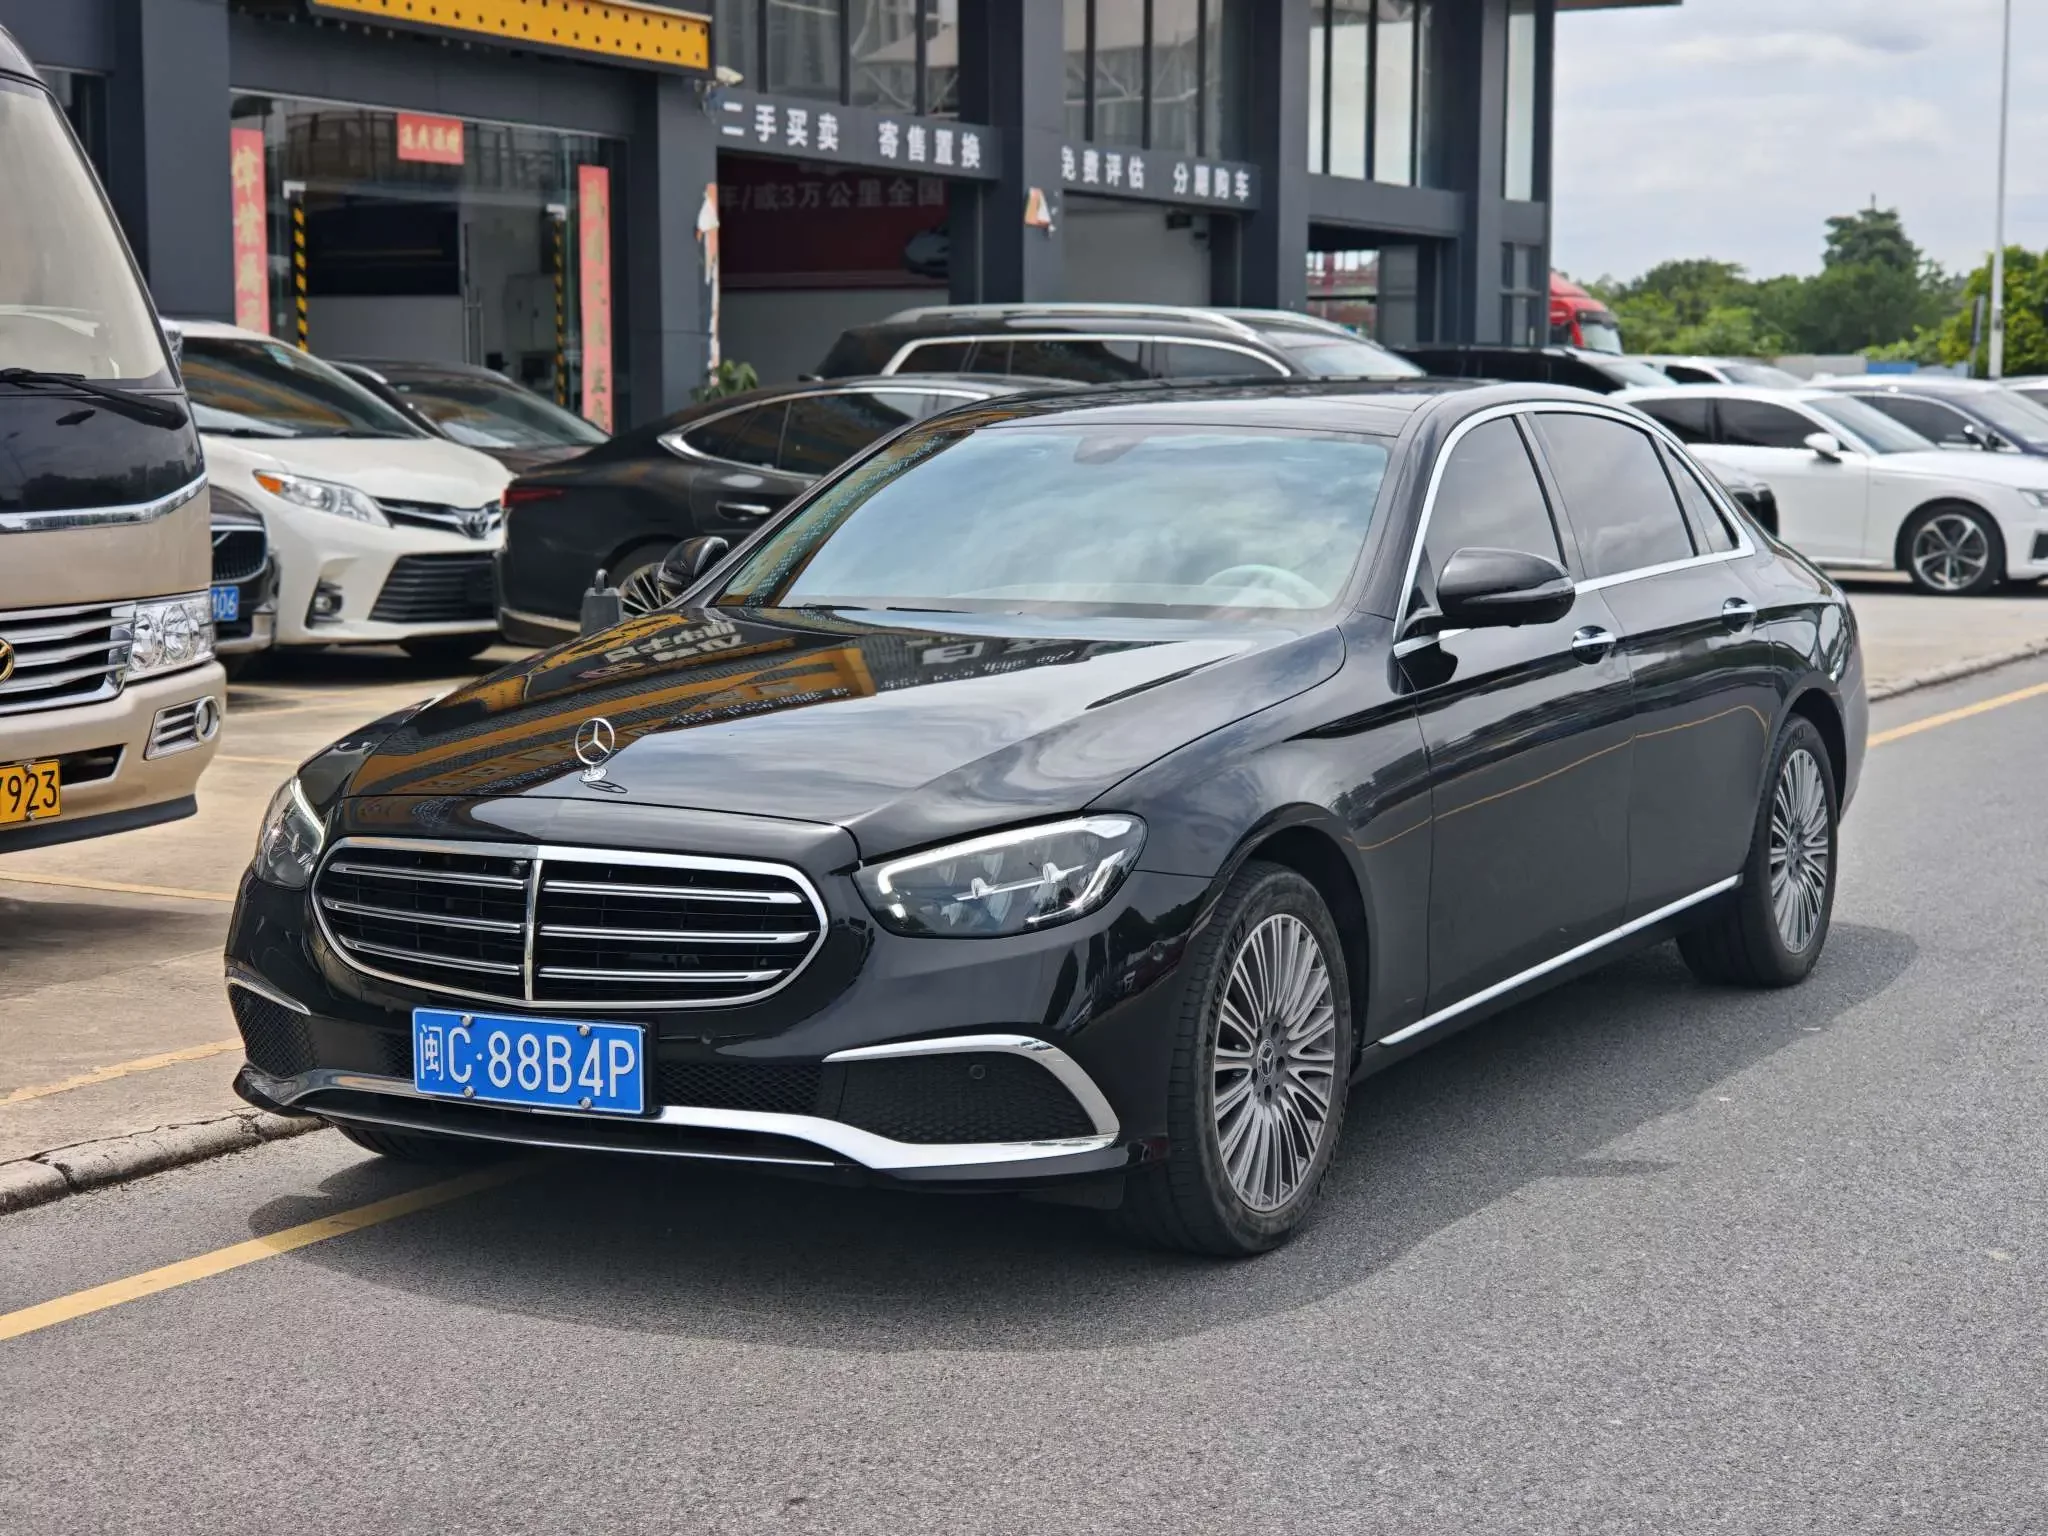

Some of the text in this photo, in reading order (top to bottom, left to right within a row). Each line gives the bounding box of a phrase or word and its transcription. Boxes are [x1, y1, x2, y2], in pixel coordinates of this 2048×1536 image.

[721, 101, 981, 169] 二手买卖 寄售置换
[0, 770, 57, 814] 923
